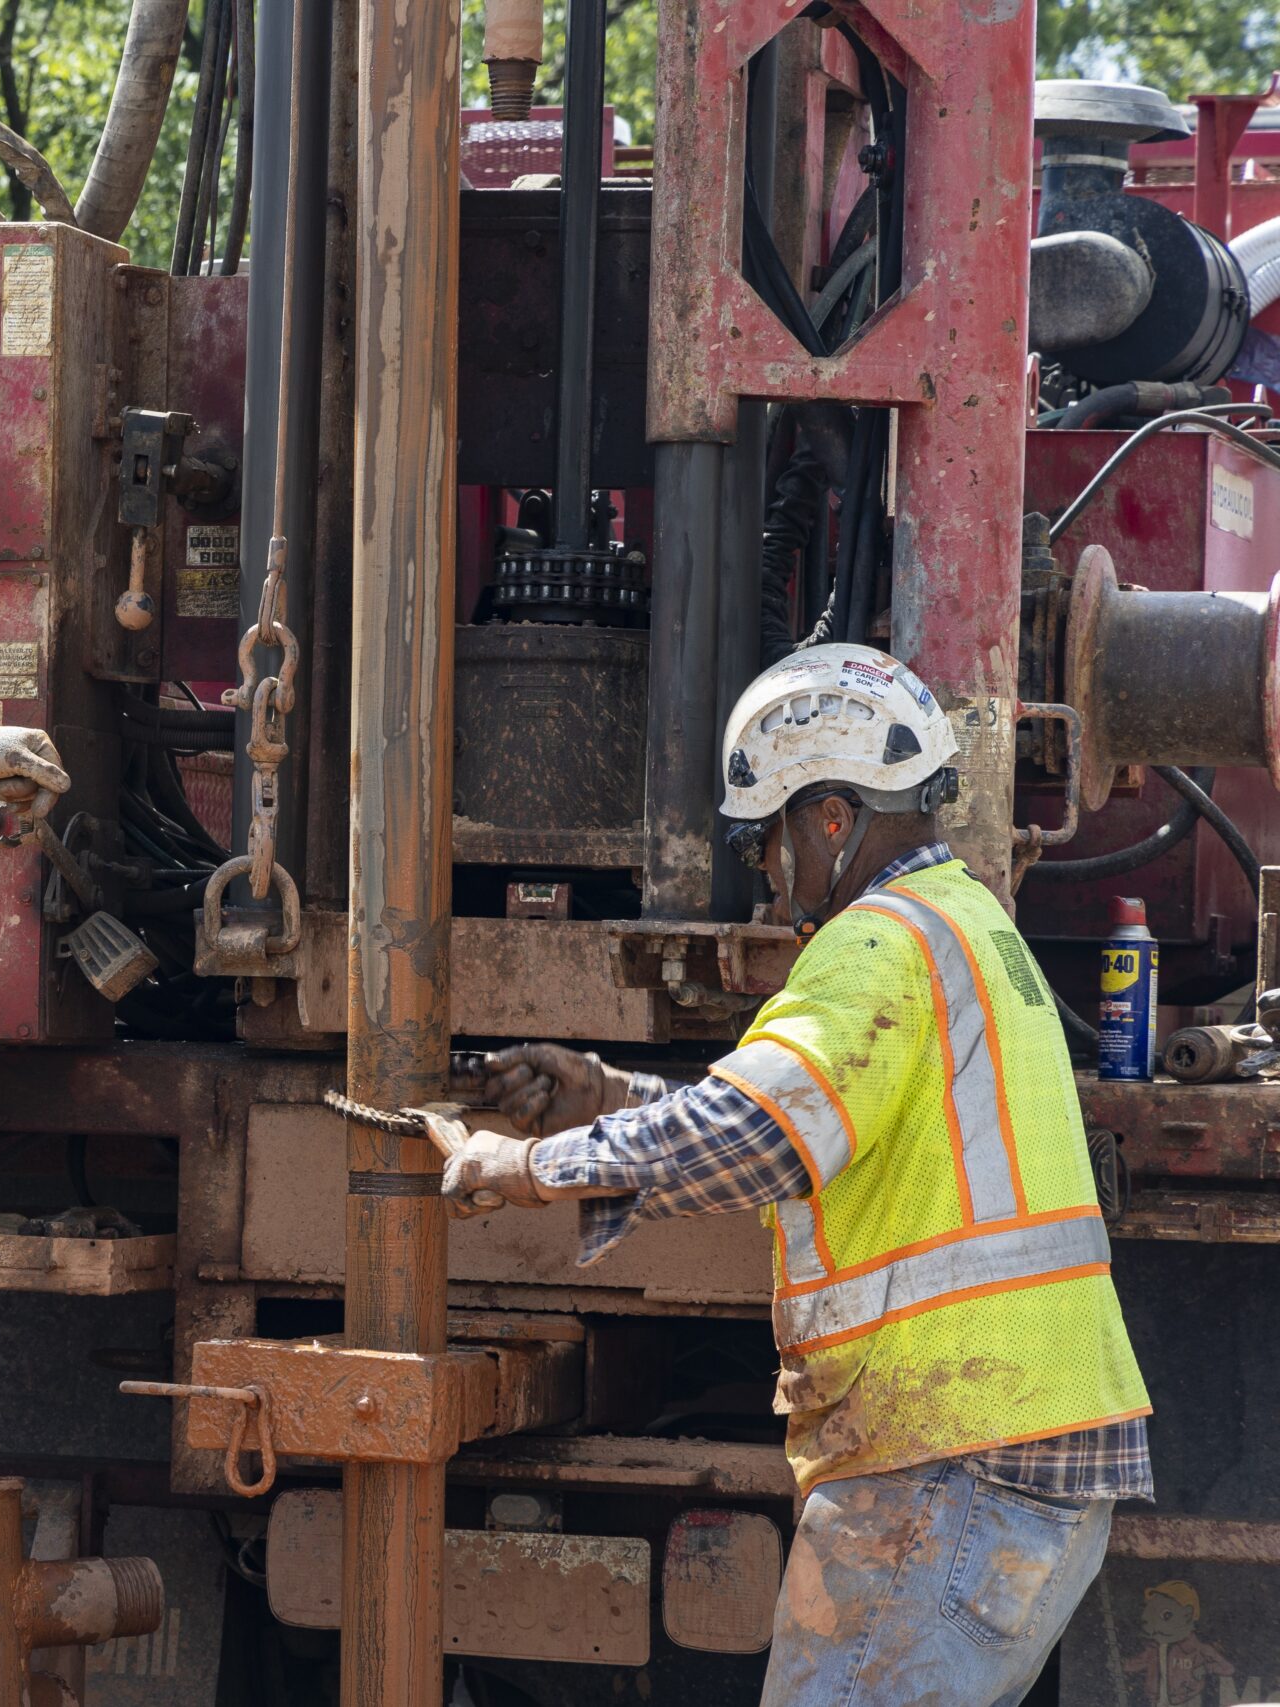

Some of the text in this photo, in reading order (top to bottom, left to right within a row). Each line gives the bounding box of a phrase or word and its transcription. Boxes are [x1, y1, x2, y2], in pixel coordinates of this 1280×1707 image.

[1213, 482, 1242, 516] HYDRAULIC
[851, 663, 888, 679] DANGER
[854, 670, 890, 688] CAREFUL
[856, 677, 873, 688] SON
